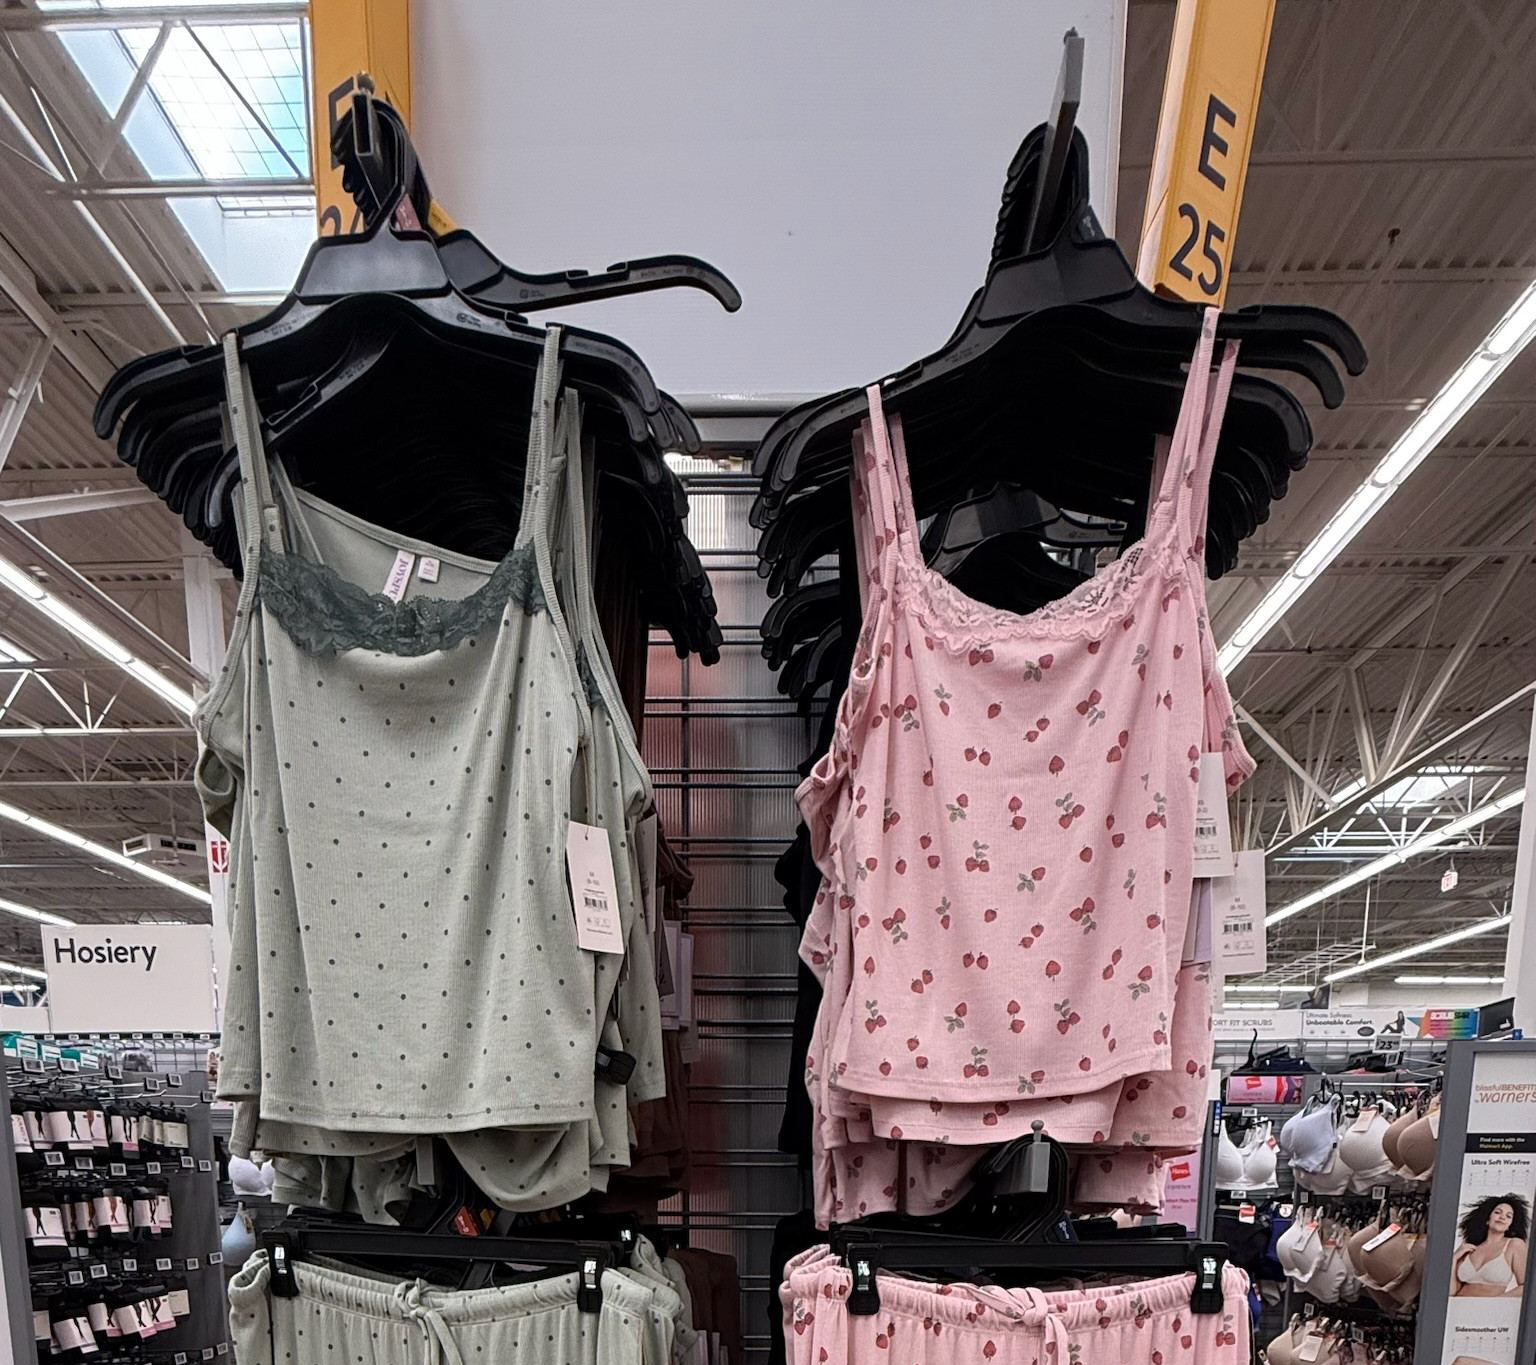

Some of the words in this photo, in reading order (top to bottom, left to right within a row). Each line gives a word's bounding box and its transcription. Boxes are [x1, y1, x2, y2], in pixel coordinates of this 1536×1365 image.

[1198, 93, 1237, 192] E
[1169, 203, 1226, 296] 25
[54, 938, 157, 971] Hosiery
